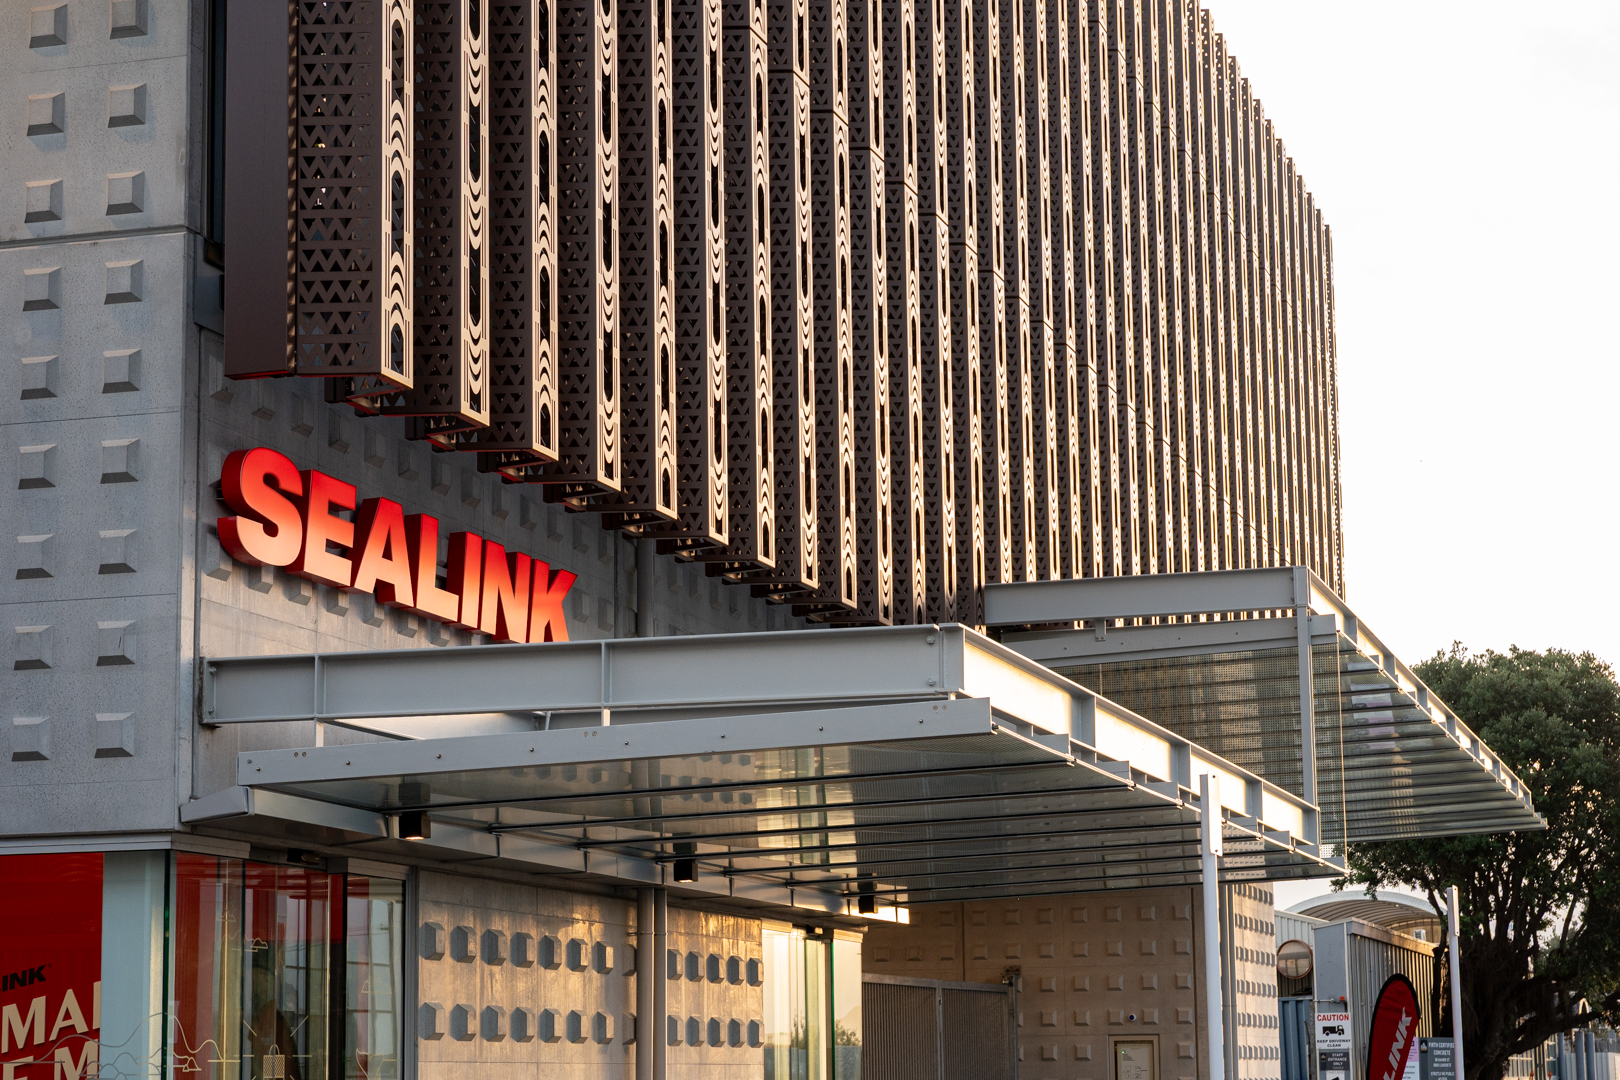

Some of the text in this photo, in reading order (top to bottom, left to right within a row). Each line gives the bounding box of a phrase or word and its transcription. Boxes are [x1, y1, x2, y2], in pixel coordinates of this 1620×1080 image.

[218, 447, 578, 643] SEALINK
[0, 964, 47, 993] INK
[1316, 1014, 1350, 1022] CAUTION
